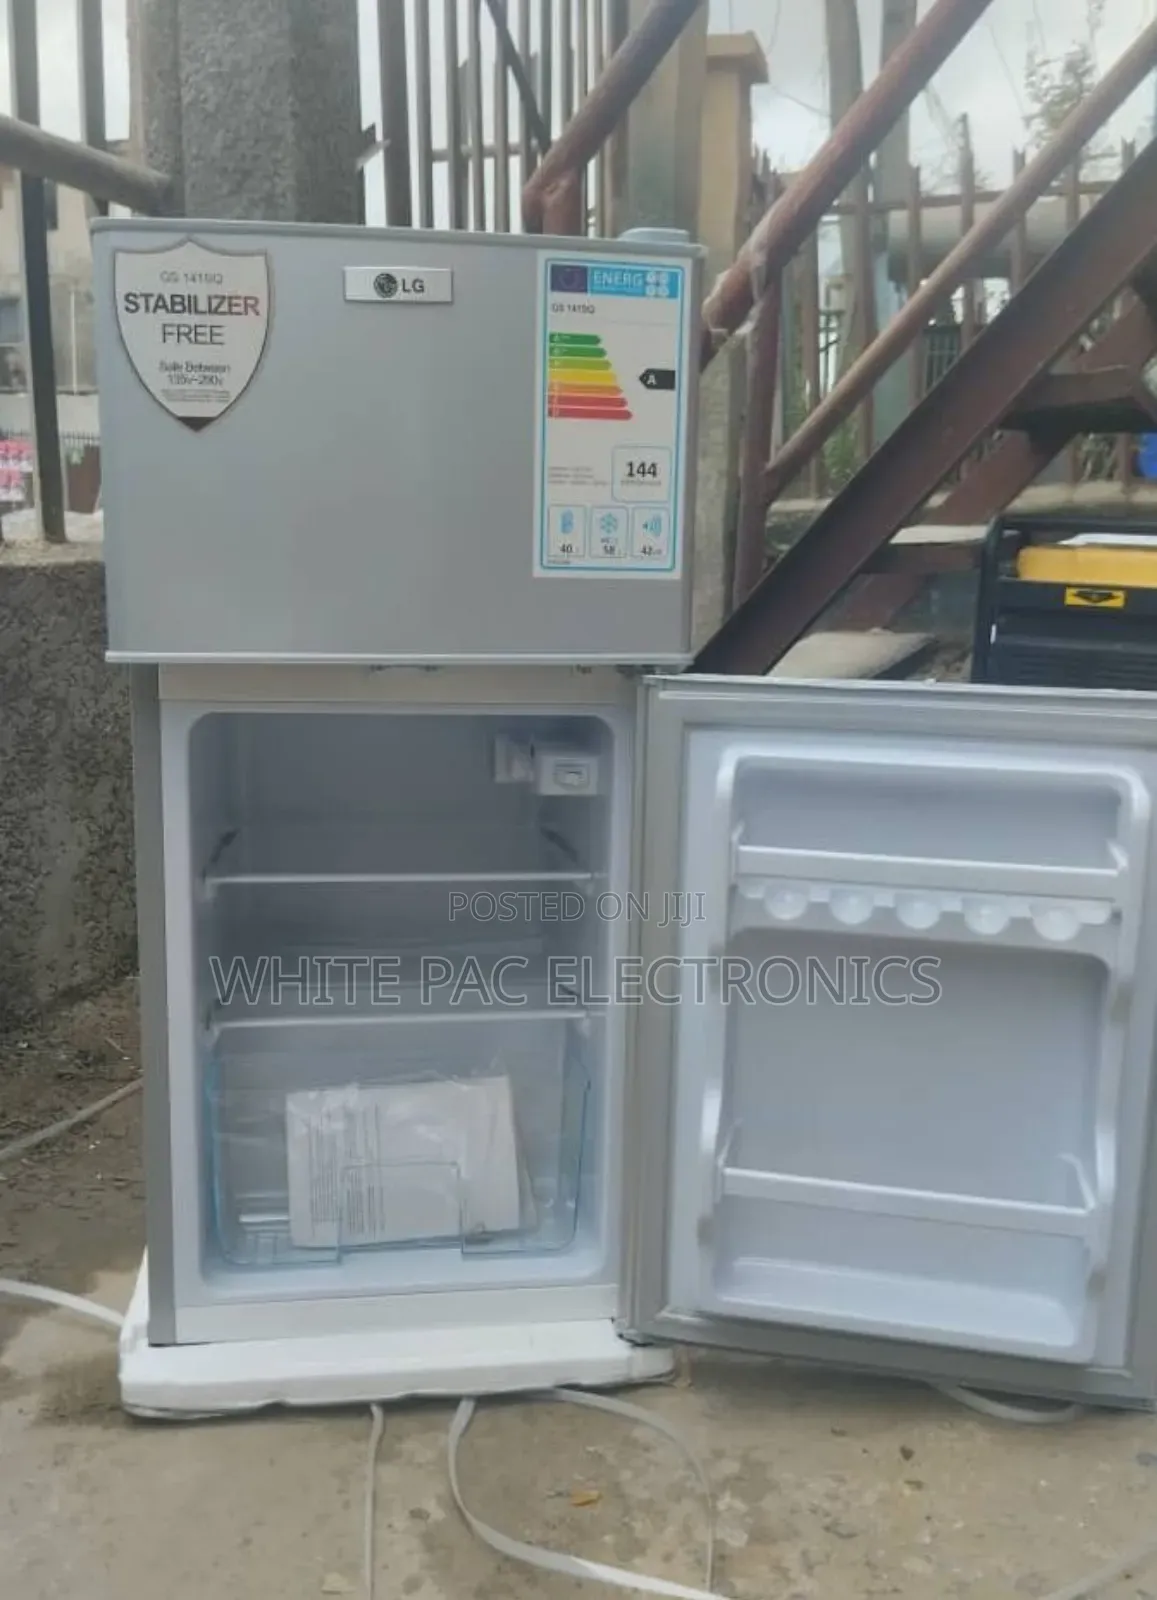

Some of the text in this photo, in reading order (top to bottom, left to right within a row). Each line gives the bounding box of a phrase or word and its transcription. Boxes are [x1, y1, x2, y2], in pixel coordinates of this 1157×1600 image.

[401, 277, 425, 294] LG
[593, 270, 644, 288] ENERG
[123, 291, 261, 317] STABILIZER
[162, 323, 225, 346] FREE
[646, 373, 658, 386] A
[625, 460, 659, 479] 144
[560, 543, 574, 554] 40
